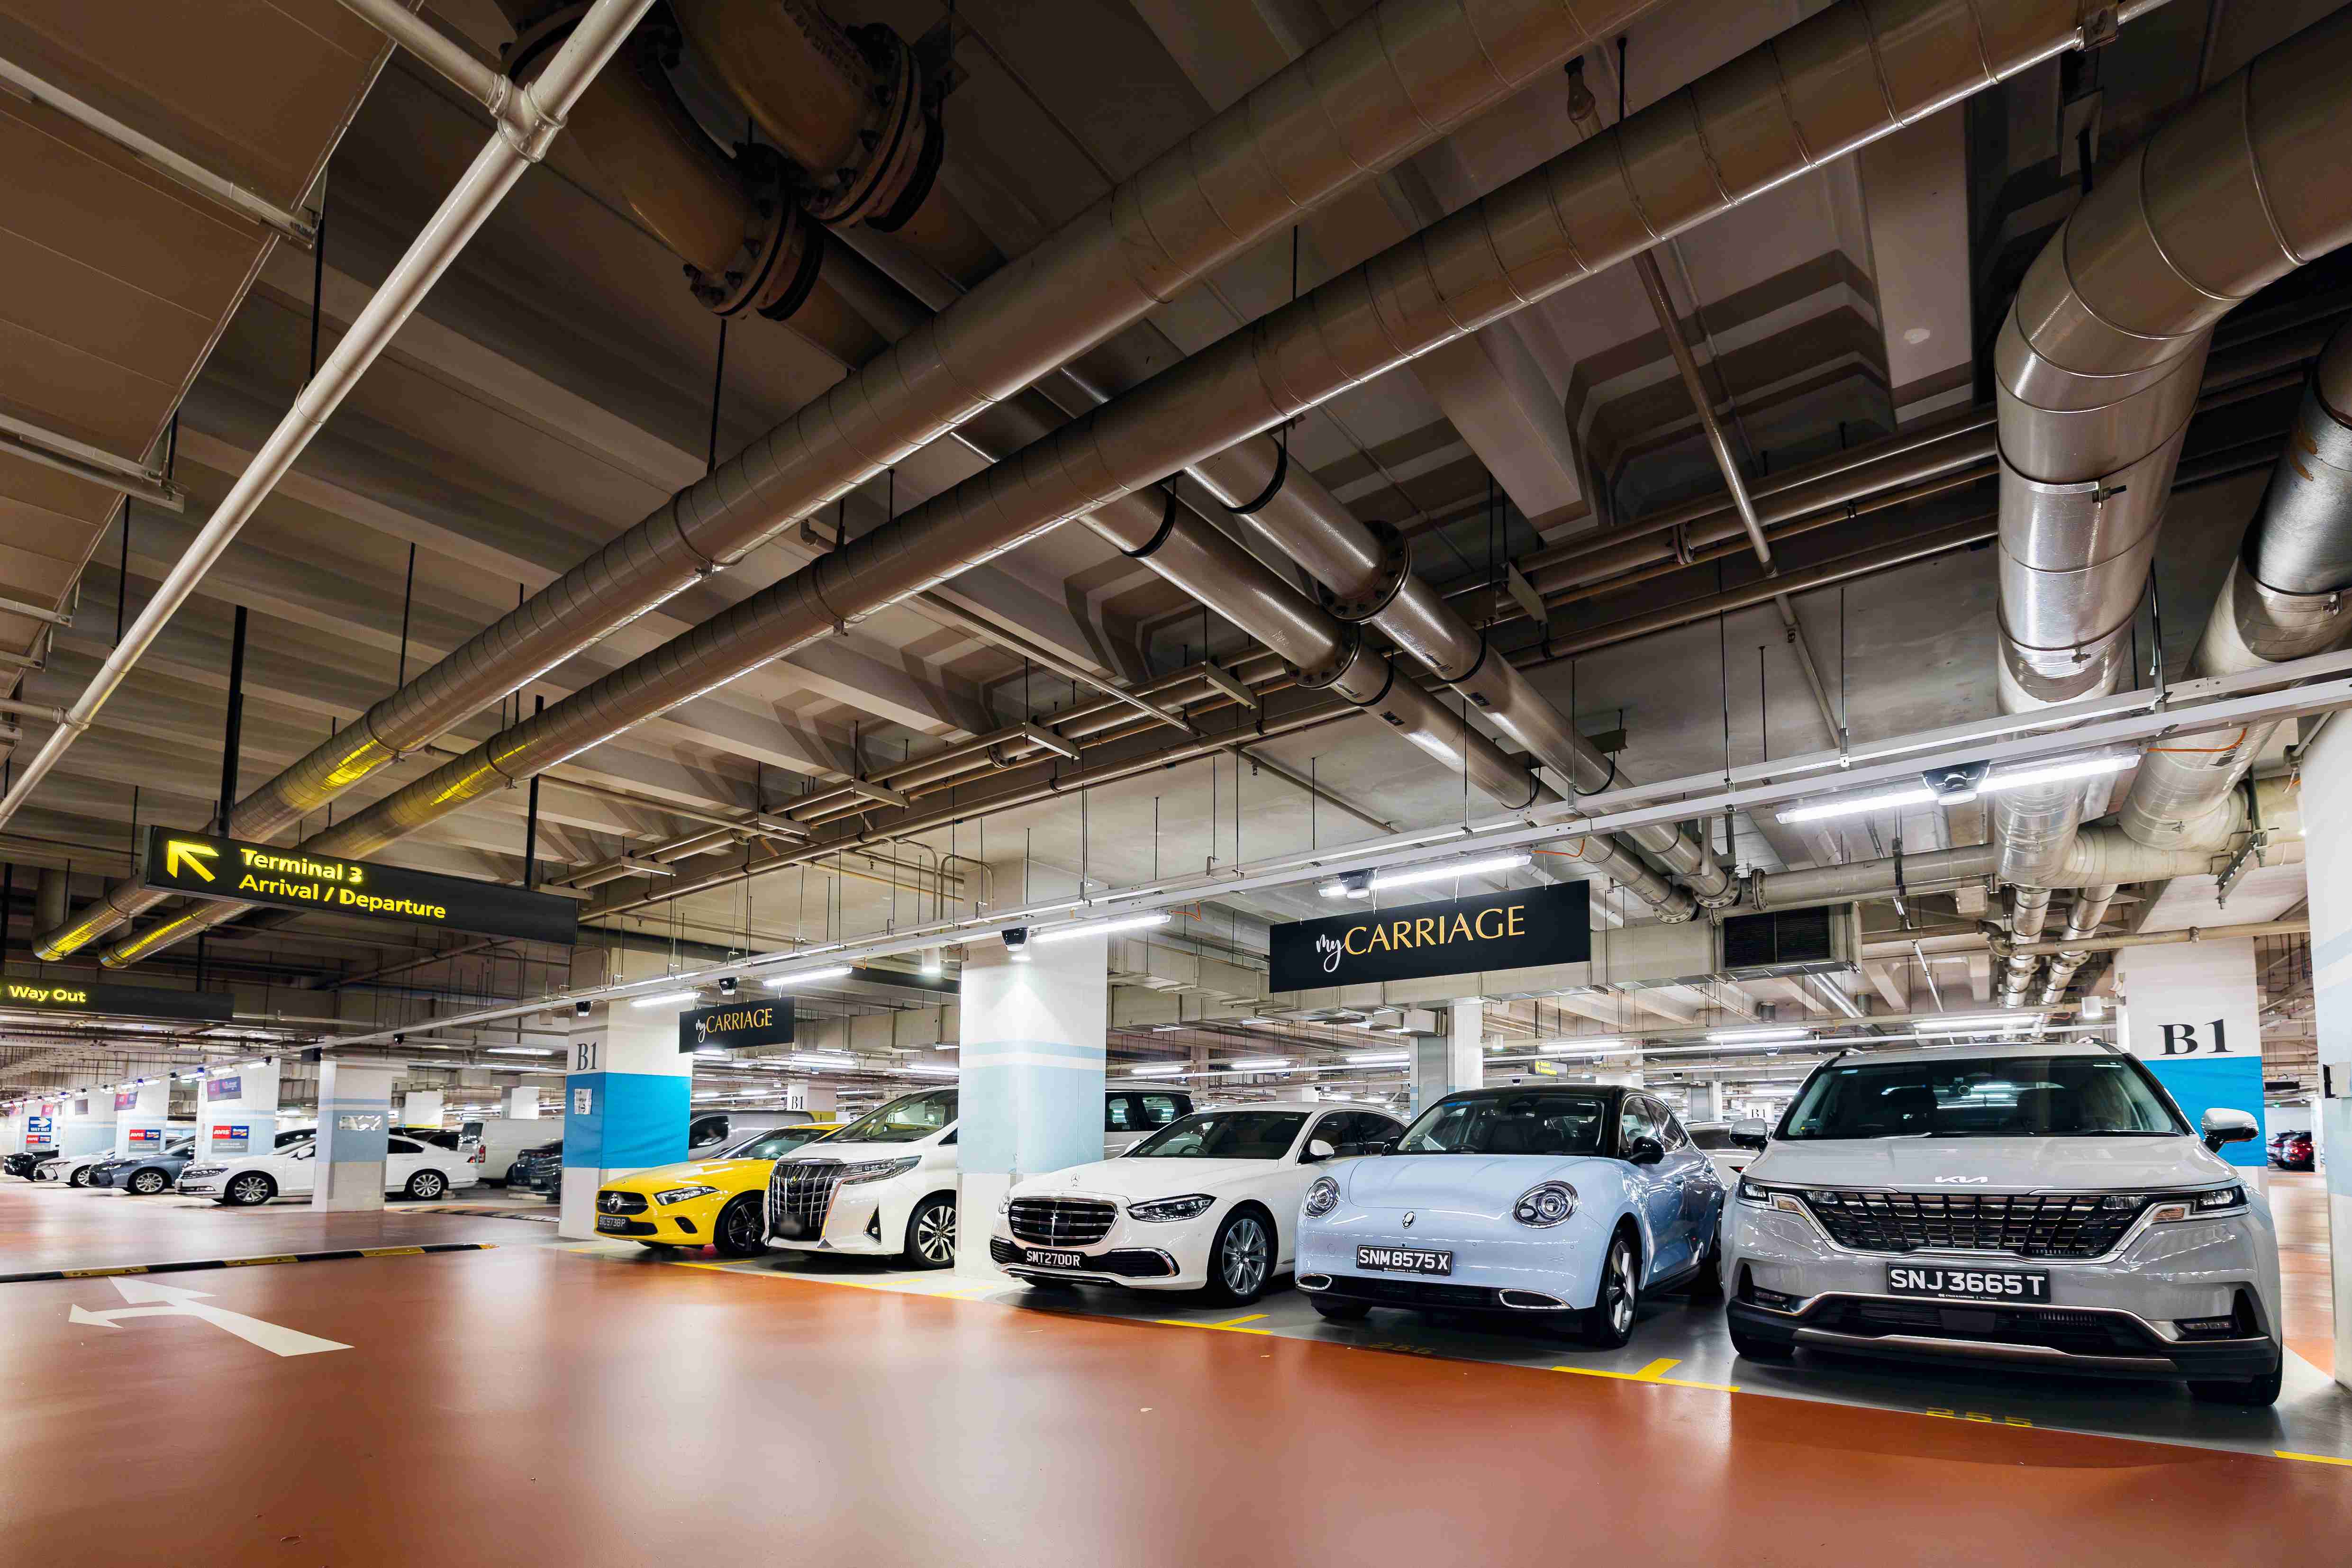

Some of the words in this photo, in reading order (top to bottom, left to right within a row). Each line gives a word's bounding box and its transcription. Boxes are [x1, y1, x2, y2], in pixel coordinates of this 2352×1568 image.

[240, 848, 342, 881] Terminal
[348, 866, 363, 883] 3
[238, 874, 319, 900] Arrival
[324, 887, 335, 902] /
[339, 888, 446, 918] Departure
[9, 985, 49, 1002] Way
[53, 988, 87, 1003] Out
[2157, 1019, 2234, 1055] B1
[575, 1042, 597, 1071] B1
[792, 1095, 804, 1109] B1
[1751, 1109, 1765, 1118] B1
[1026, 1251, 1081, 1267] SMT2700R
